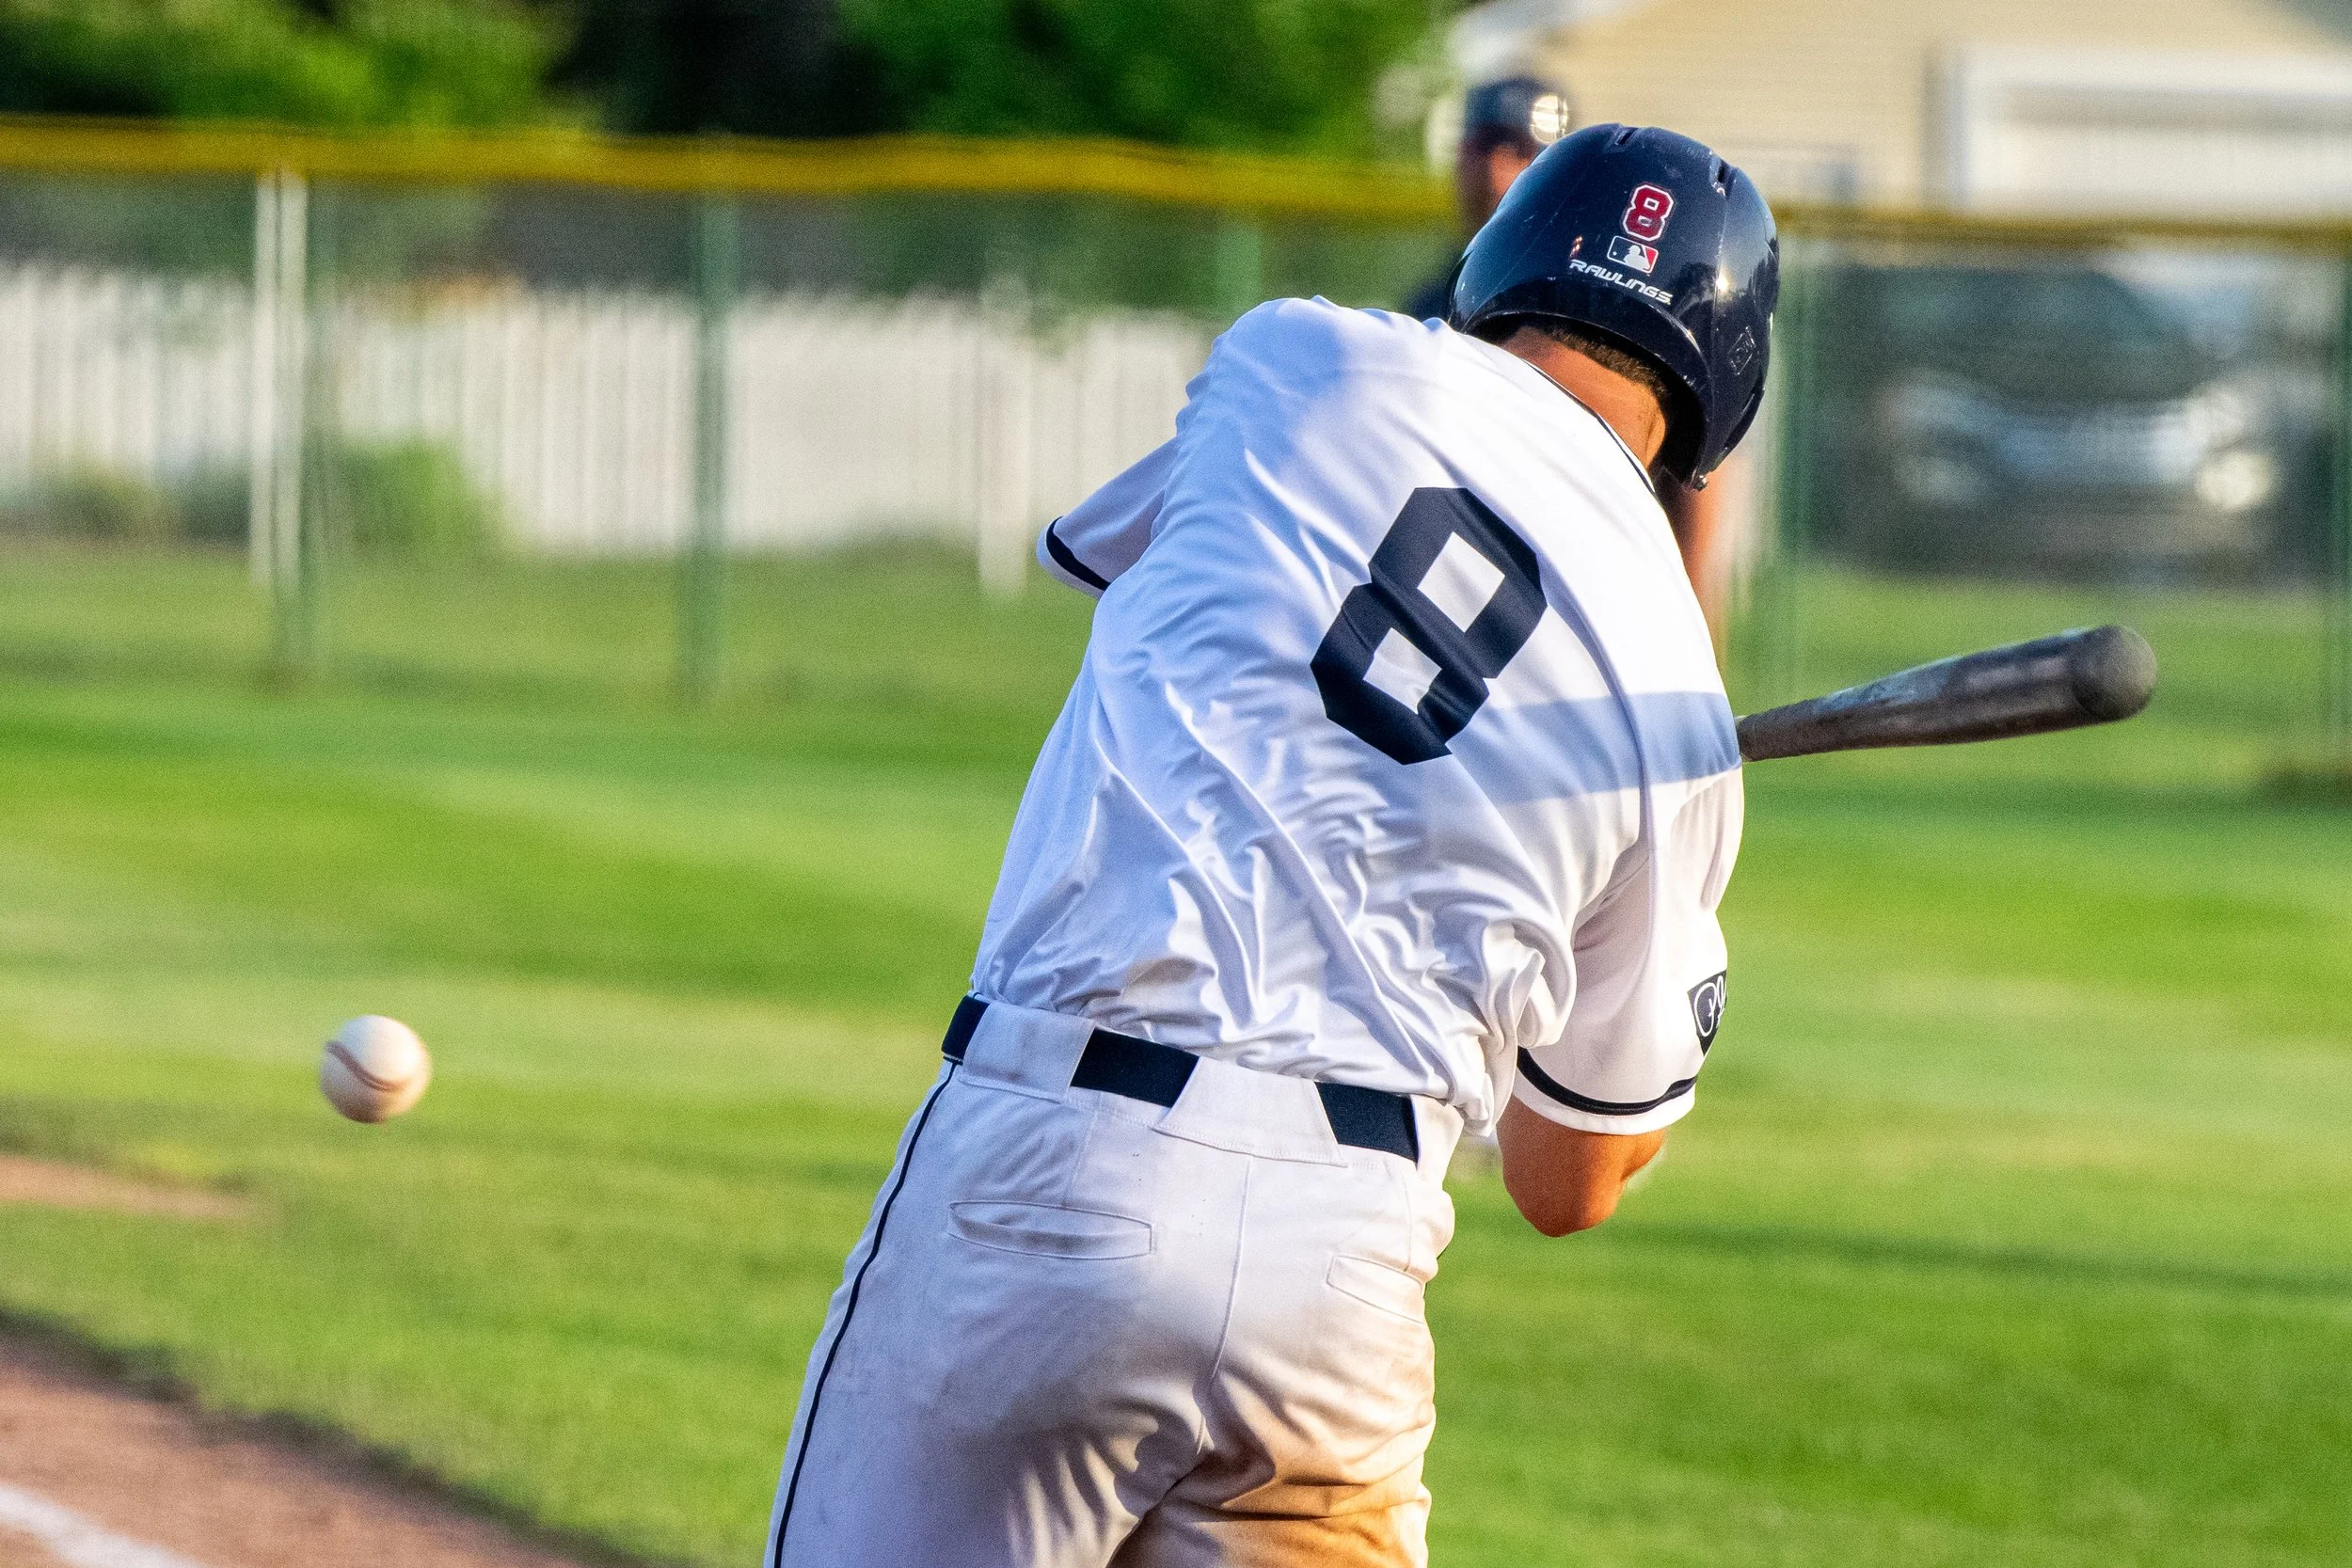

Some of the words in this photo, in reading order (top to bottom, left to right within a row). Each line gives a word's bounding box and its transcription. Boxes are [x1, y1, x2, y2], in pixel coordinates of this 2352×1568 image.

[1622, 183, 1675, 242] 8
[1569, 259, 1674, 304] RAWLINGS
[1310, 486, 1549, 766] 8
